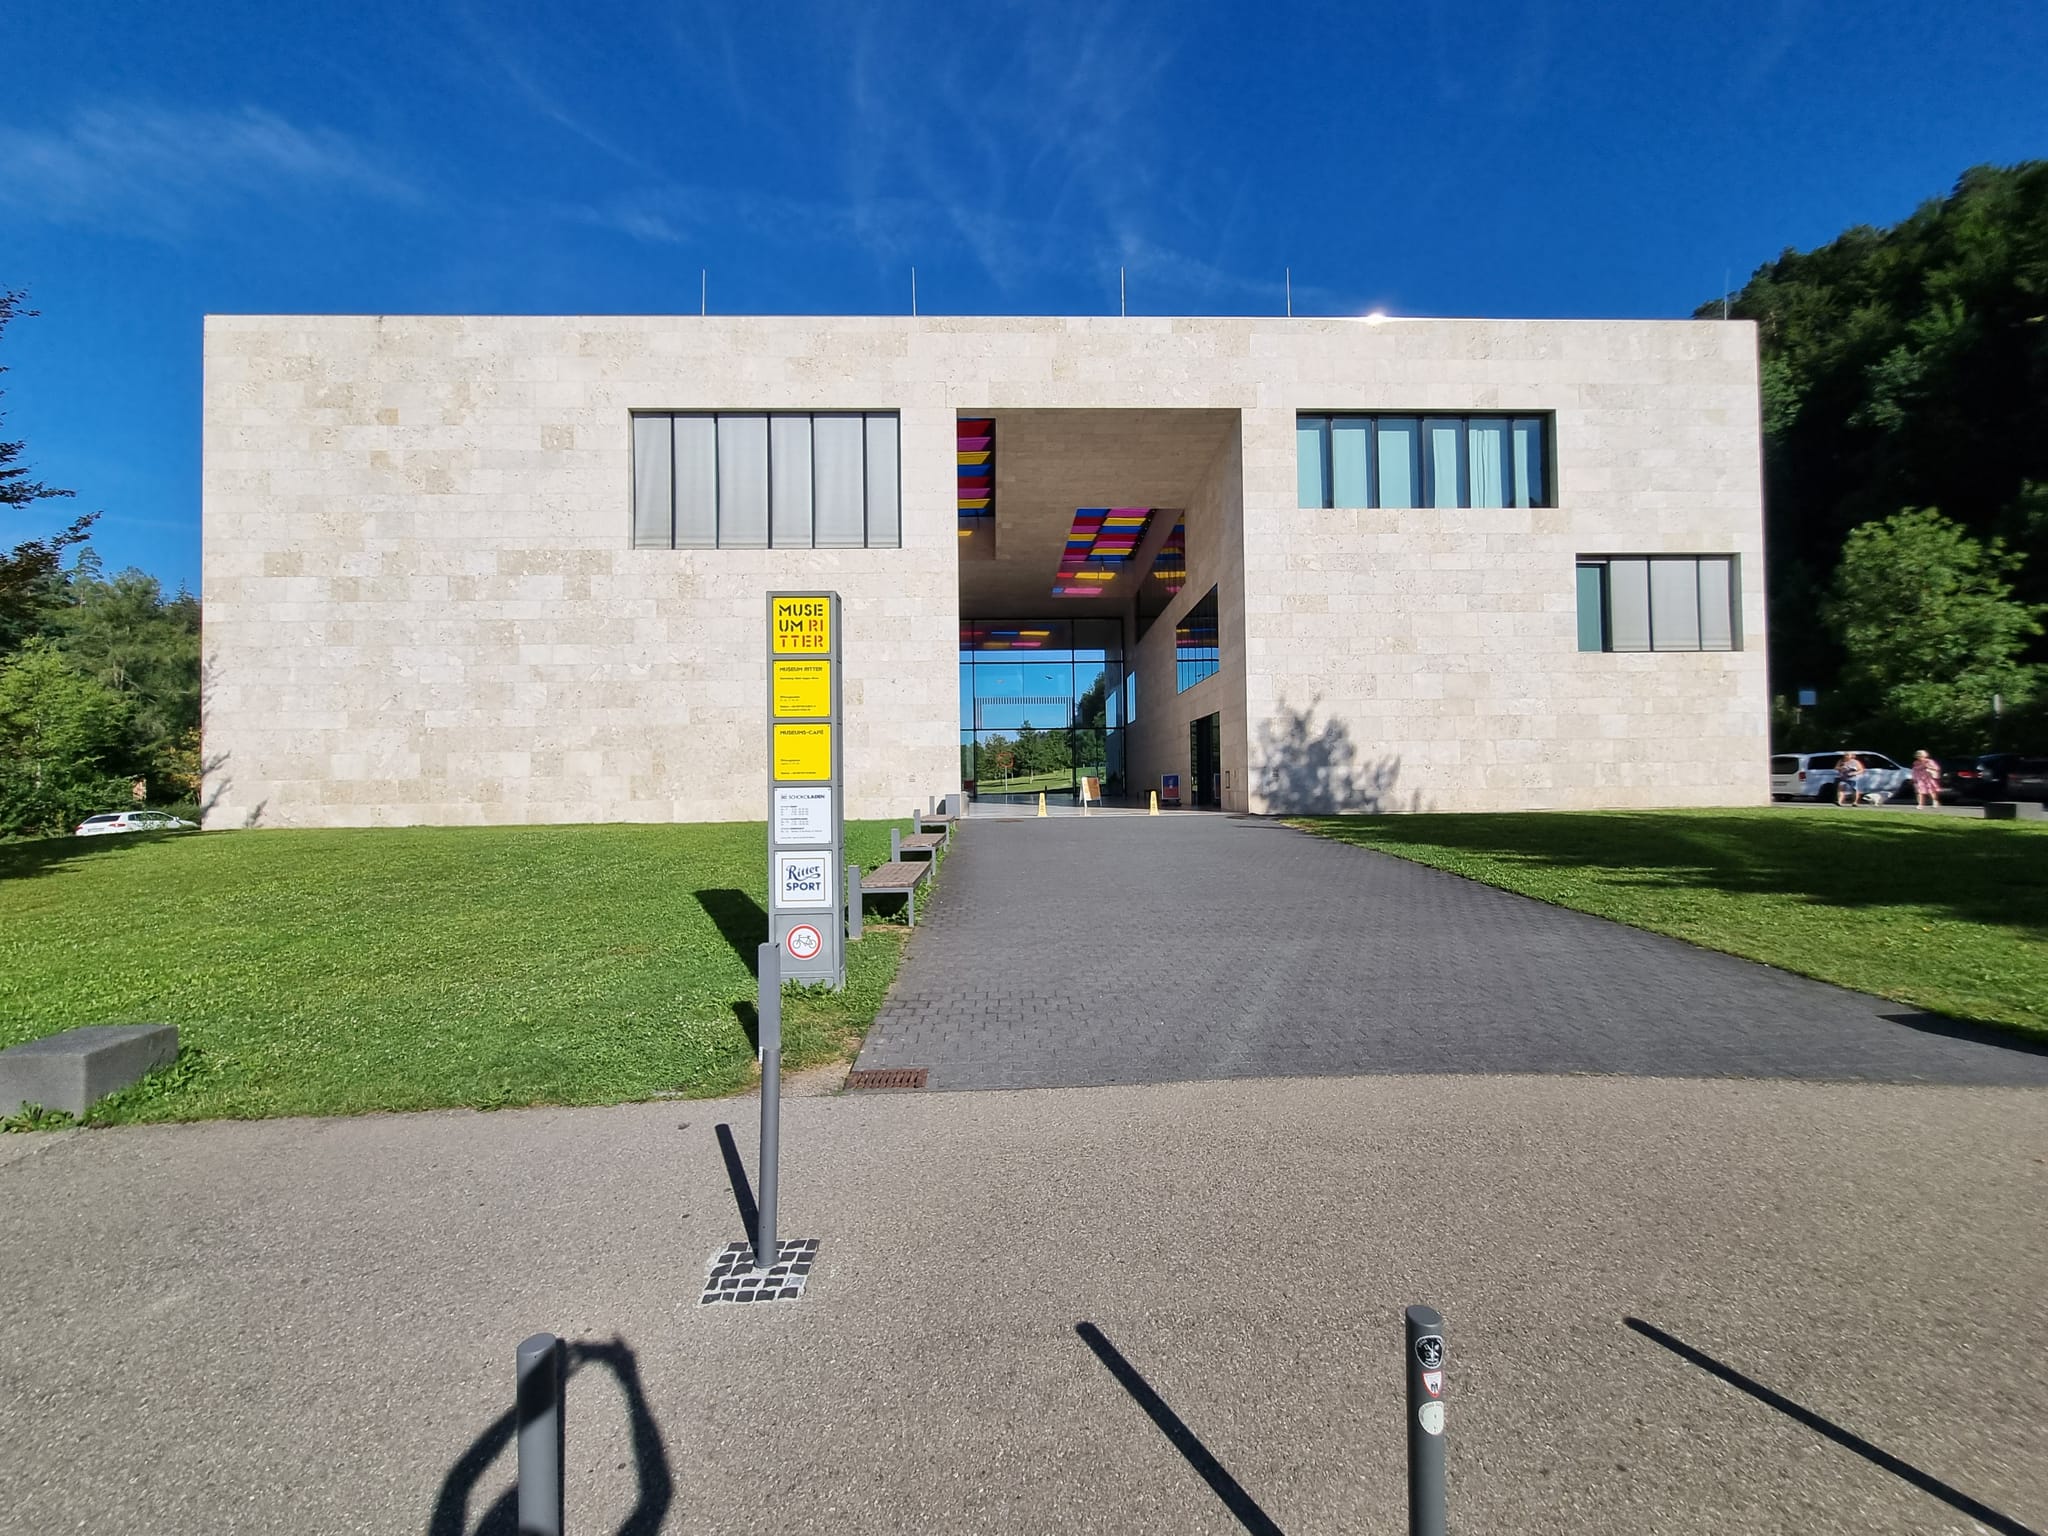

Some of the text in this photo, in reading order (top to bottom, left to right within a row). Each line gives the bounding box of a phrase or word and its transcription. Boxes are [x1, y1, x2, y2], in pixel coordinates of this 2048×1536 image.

[779, 604, 823, 616] MUSE
[779, 619, 823, 632] UM RI
[779, 635, 823, 648] TTER
[786, 865, 821, 881] Ritter
[786, 882, 821, 891] SPORT
